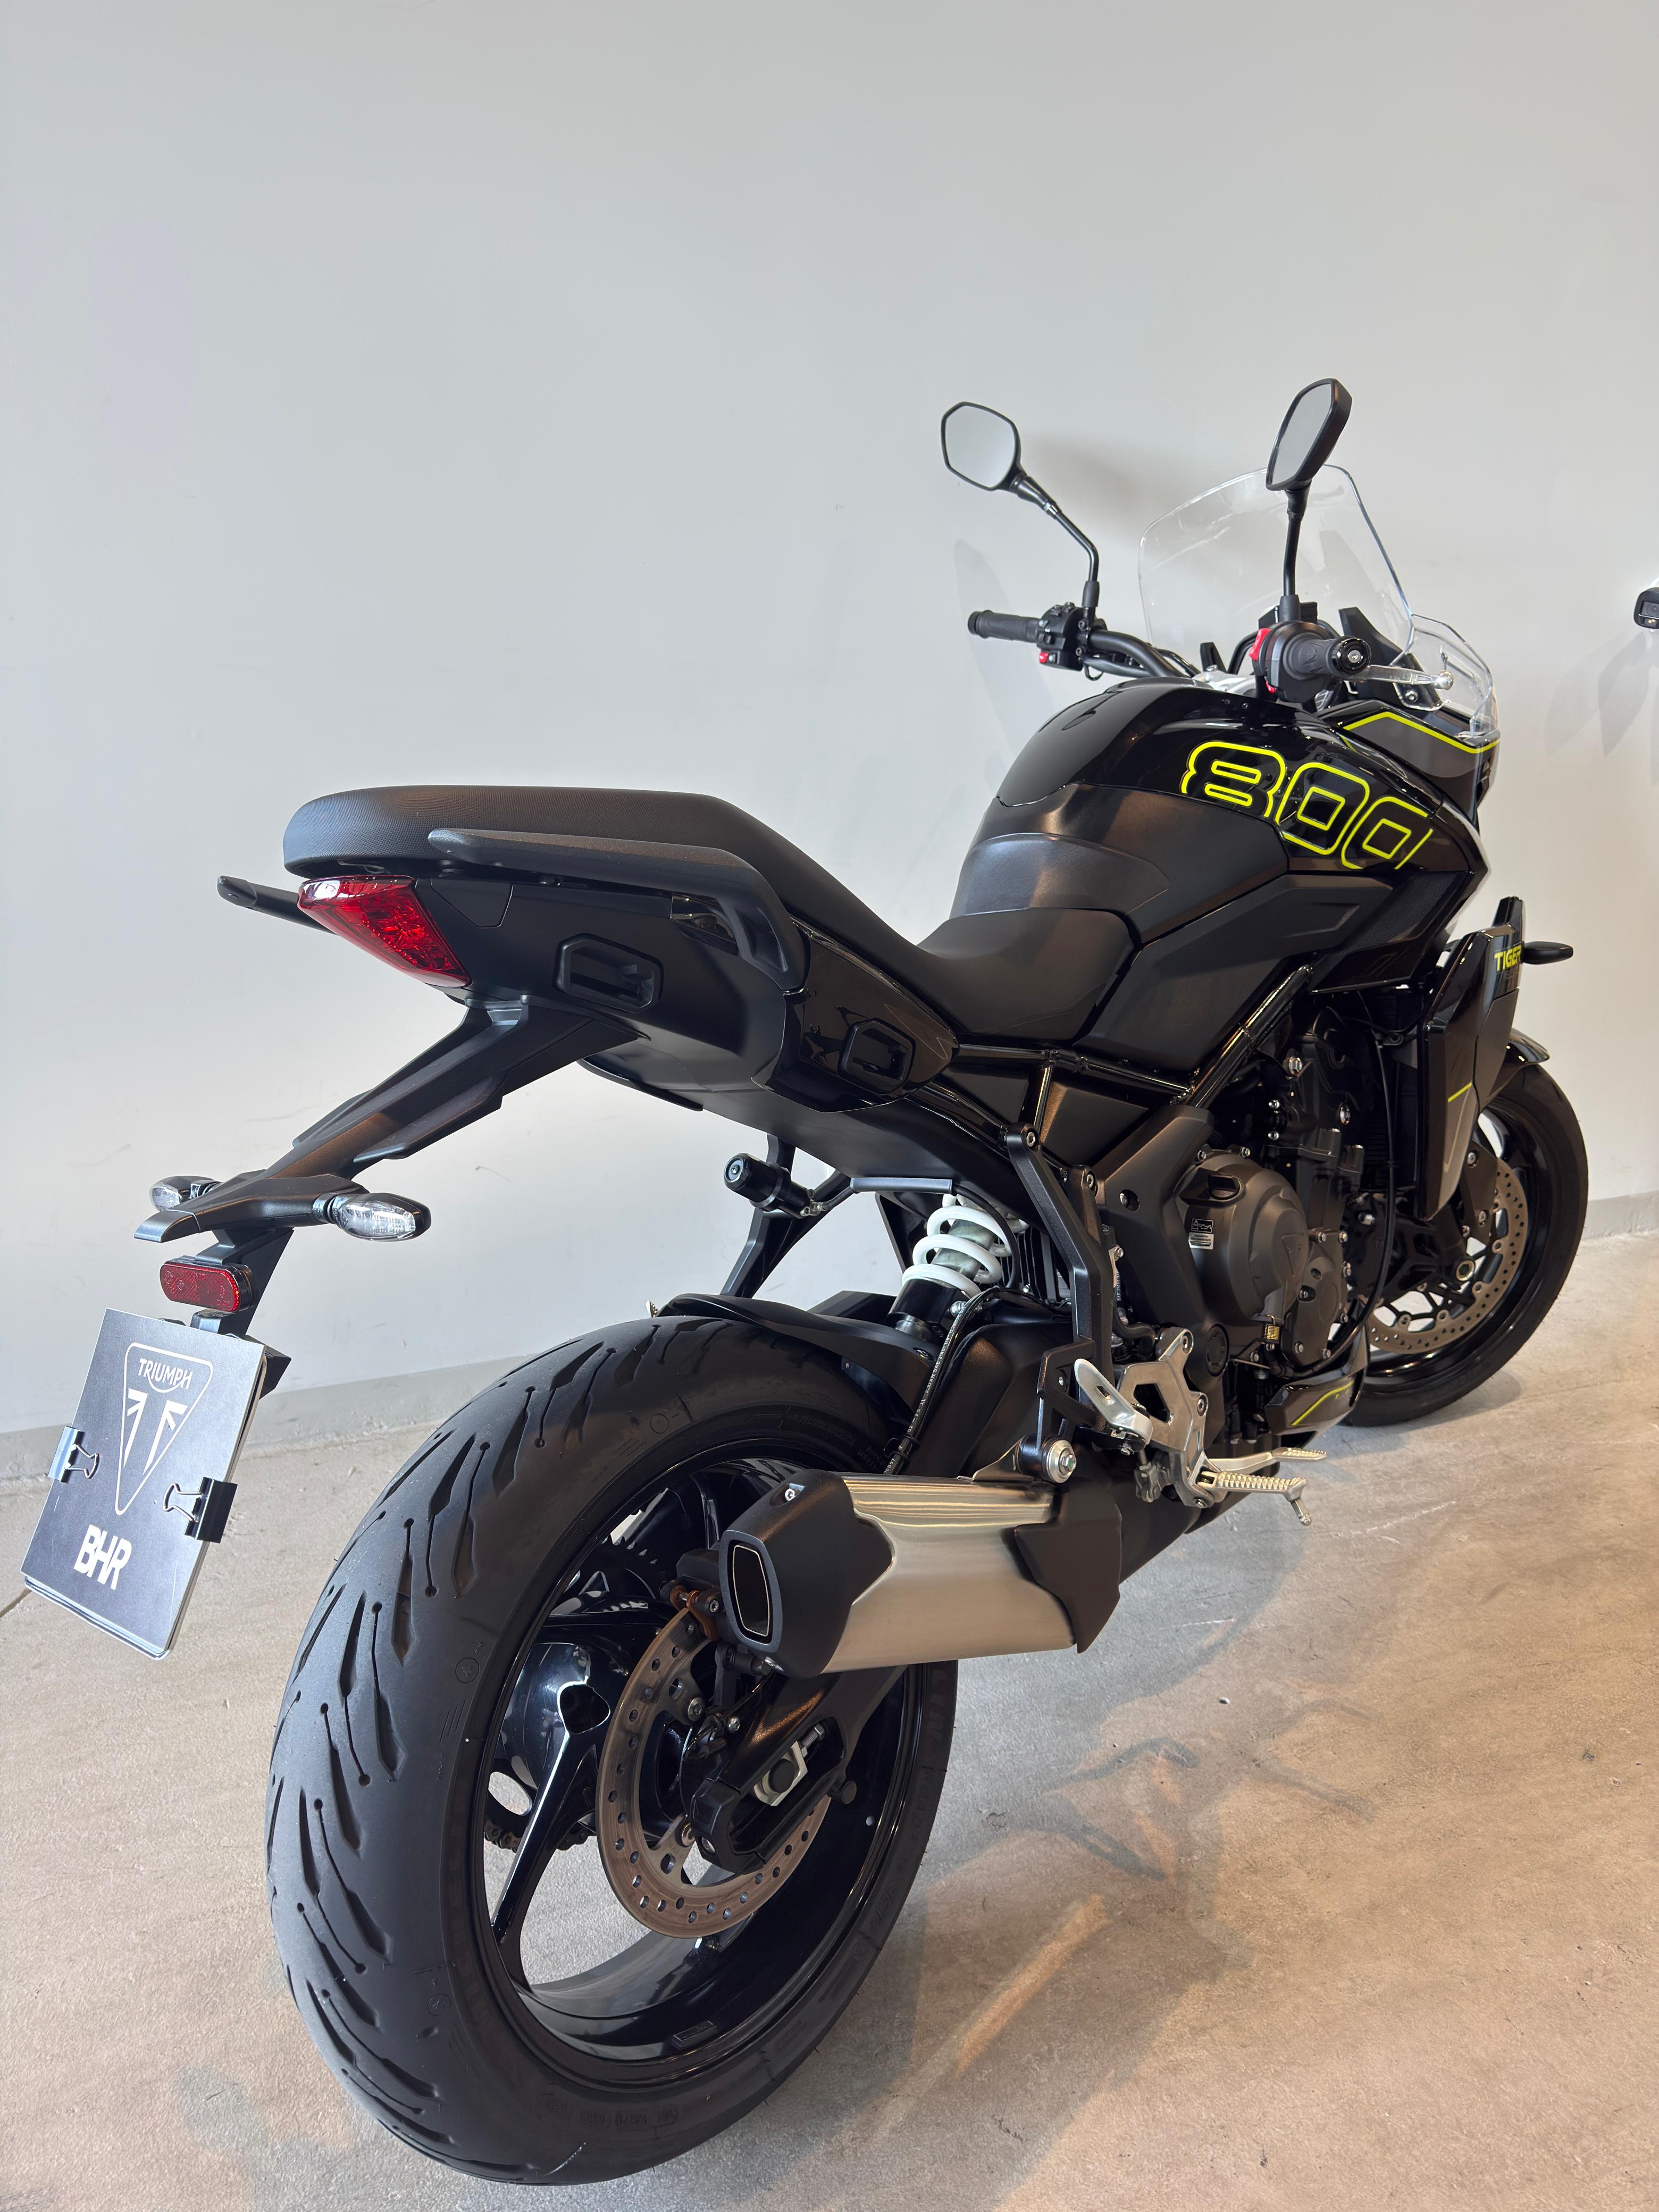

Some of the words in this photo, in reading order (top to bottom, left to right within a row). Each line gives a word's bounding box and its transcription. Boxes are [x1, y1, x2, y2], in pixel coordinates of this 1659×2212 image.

[1179, 741, 1434, 870] 800
[1494, 944, 1522, 972] TIGER
[138, 1358, 194, 1390] TRIUMPH
[73, 1524, 132, 1591] BHR
